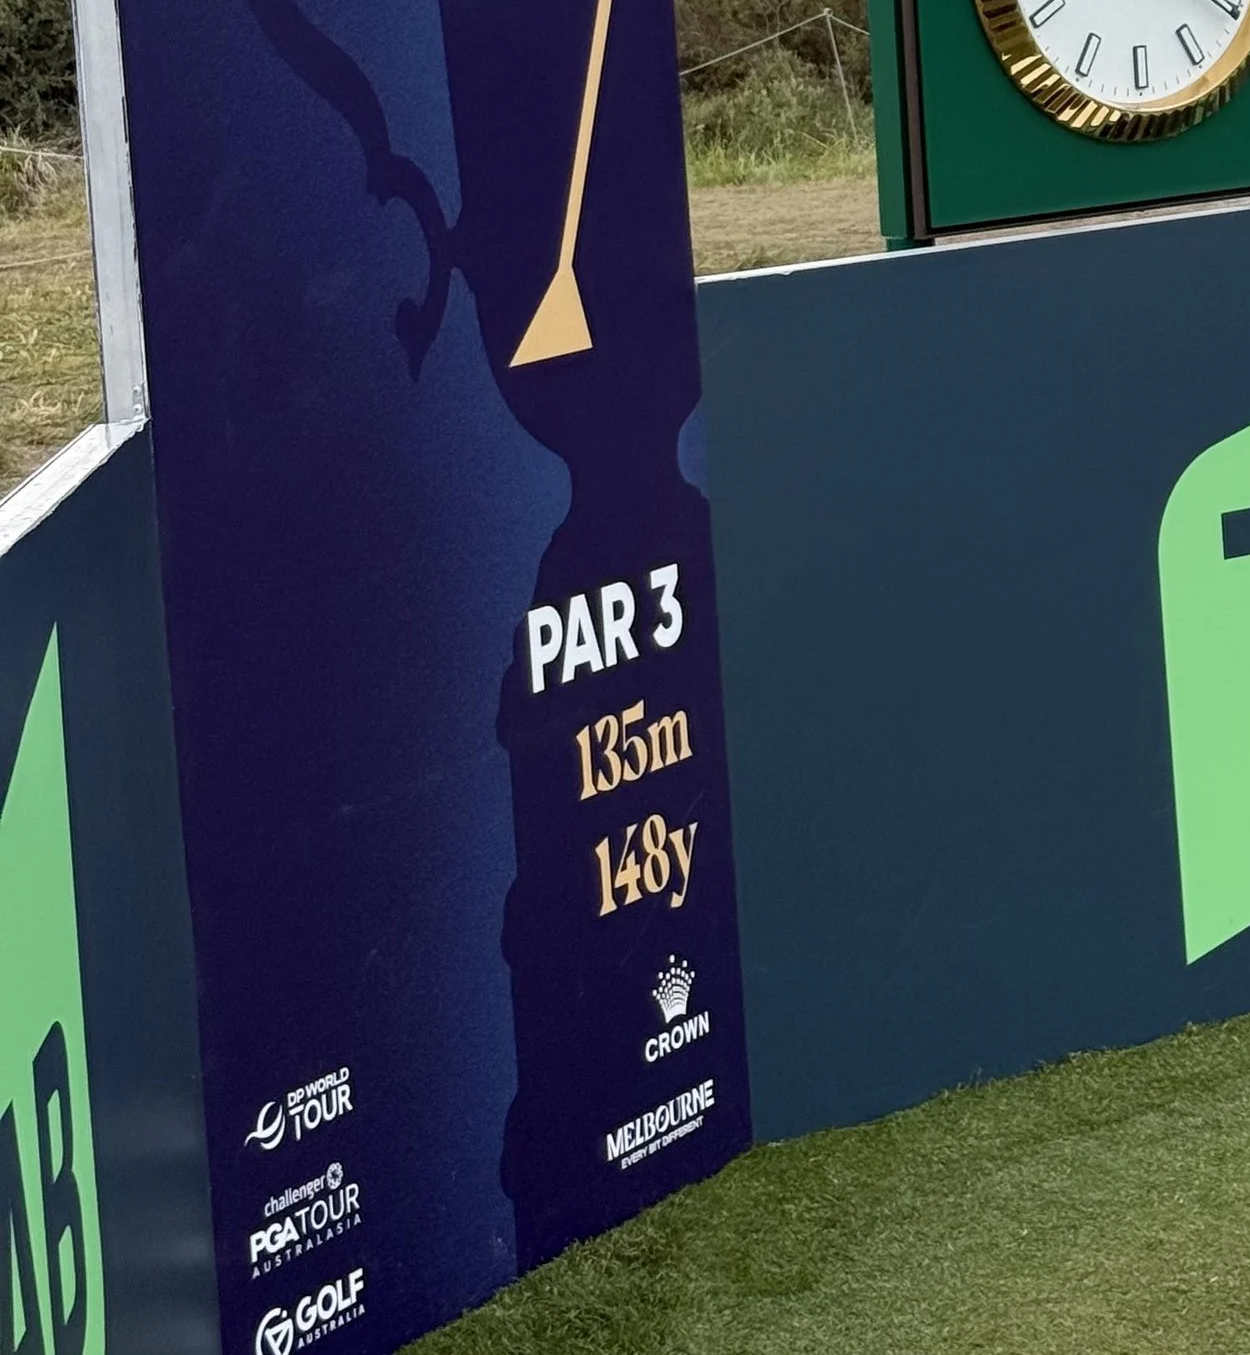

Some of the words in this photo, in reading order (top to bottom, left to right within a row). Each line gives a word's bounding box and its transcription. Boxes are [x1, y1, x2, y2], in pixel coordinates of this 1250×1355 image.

[528, 582, 640, 694] PAR
[650, 563, 683, 648] 3
[575, 699, 693, 801] 135m
[594, 814, 698, 917] 148y
[645, 1011, 711, 1063] CROWN
[287, 1088, 305, 1108] DP
[305, 1067, 350, 1098] WORLD
[288, 1084, 354, 1141] TOUR
[606, 1079, 715, 1162] MELBOURNE
[621, 1142, 650, 1170] EVERY
[662, 1115, 705, 1148] DIFFERENT
[264, 1174, 326, 1218] challenger
[252, 1213, 362, 1280] AUSTRALASIA
[295, 1267, 364, 1332] GOLF
[297, 1303, 366, 1350] AUSTRALIA
